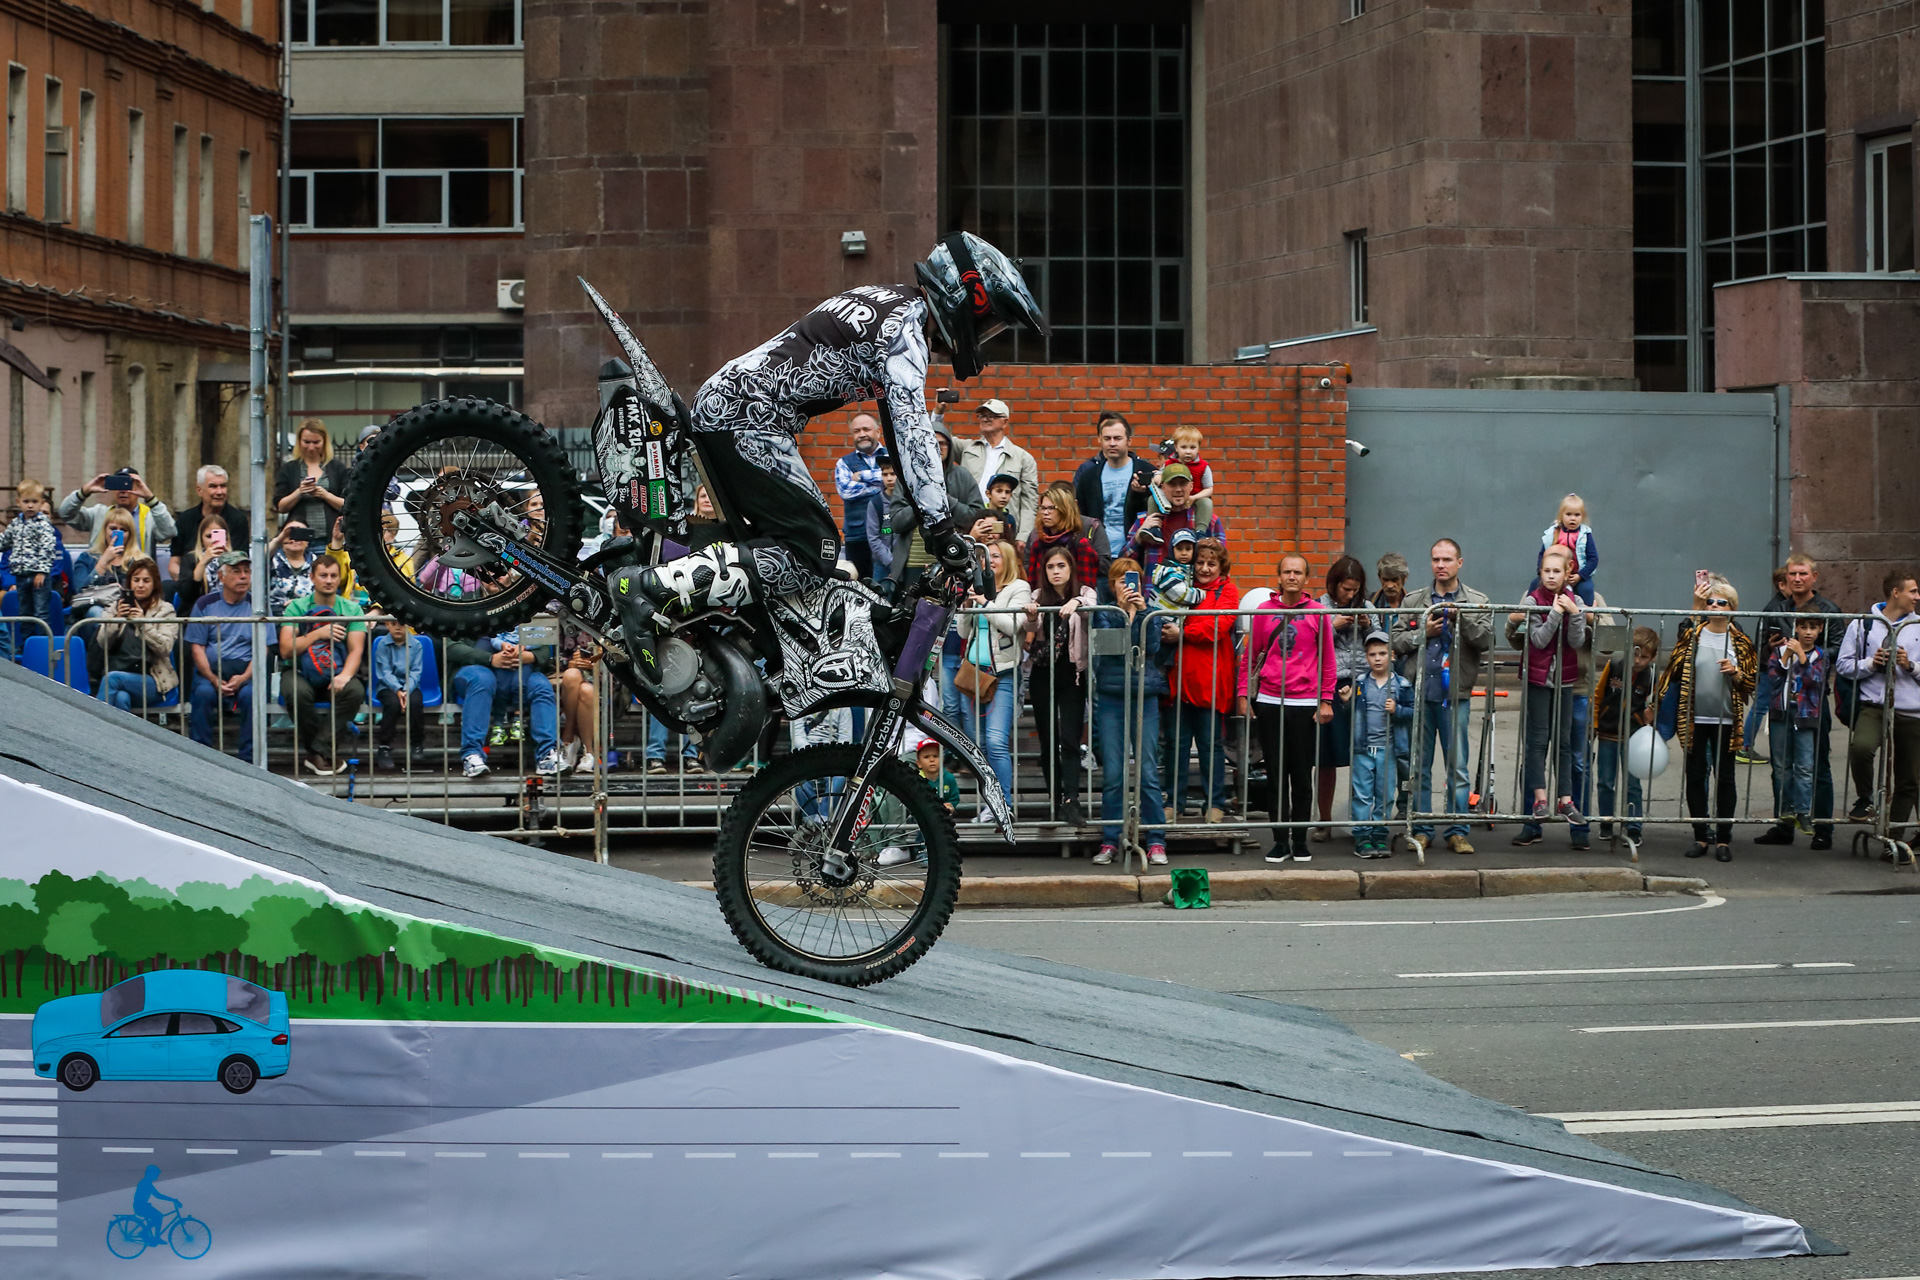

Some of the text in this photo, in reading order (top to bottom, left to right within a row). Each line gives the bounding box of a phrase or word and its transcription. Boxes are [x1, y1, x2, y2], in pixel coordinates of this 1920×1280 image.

[625, 395, 643, 447] FMX.RU
[652, 450, 661, 478] YAMAHA
[630, 480, 639, 509] SENA
[658, 492, 667, 514] Castrol
[506, 542, 570, 589] Bohnenkamp
[848, 784, 876, 843] KENDA
